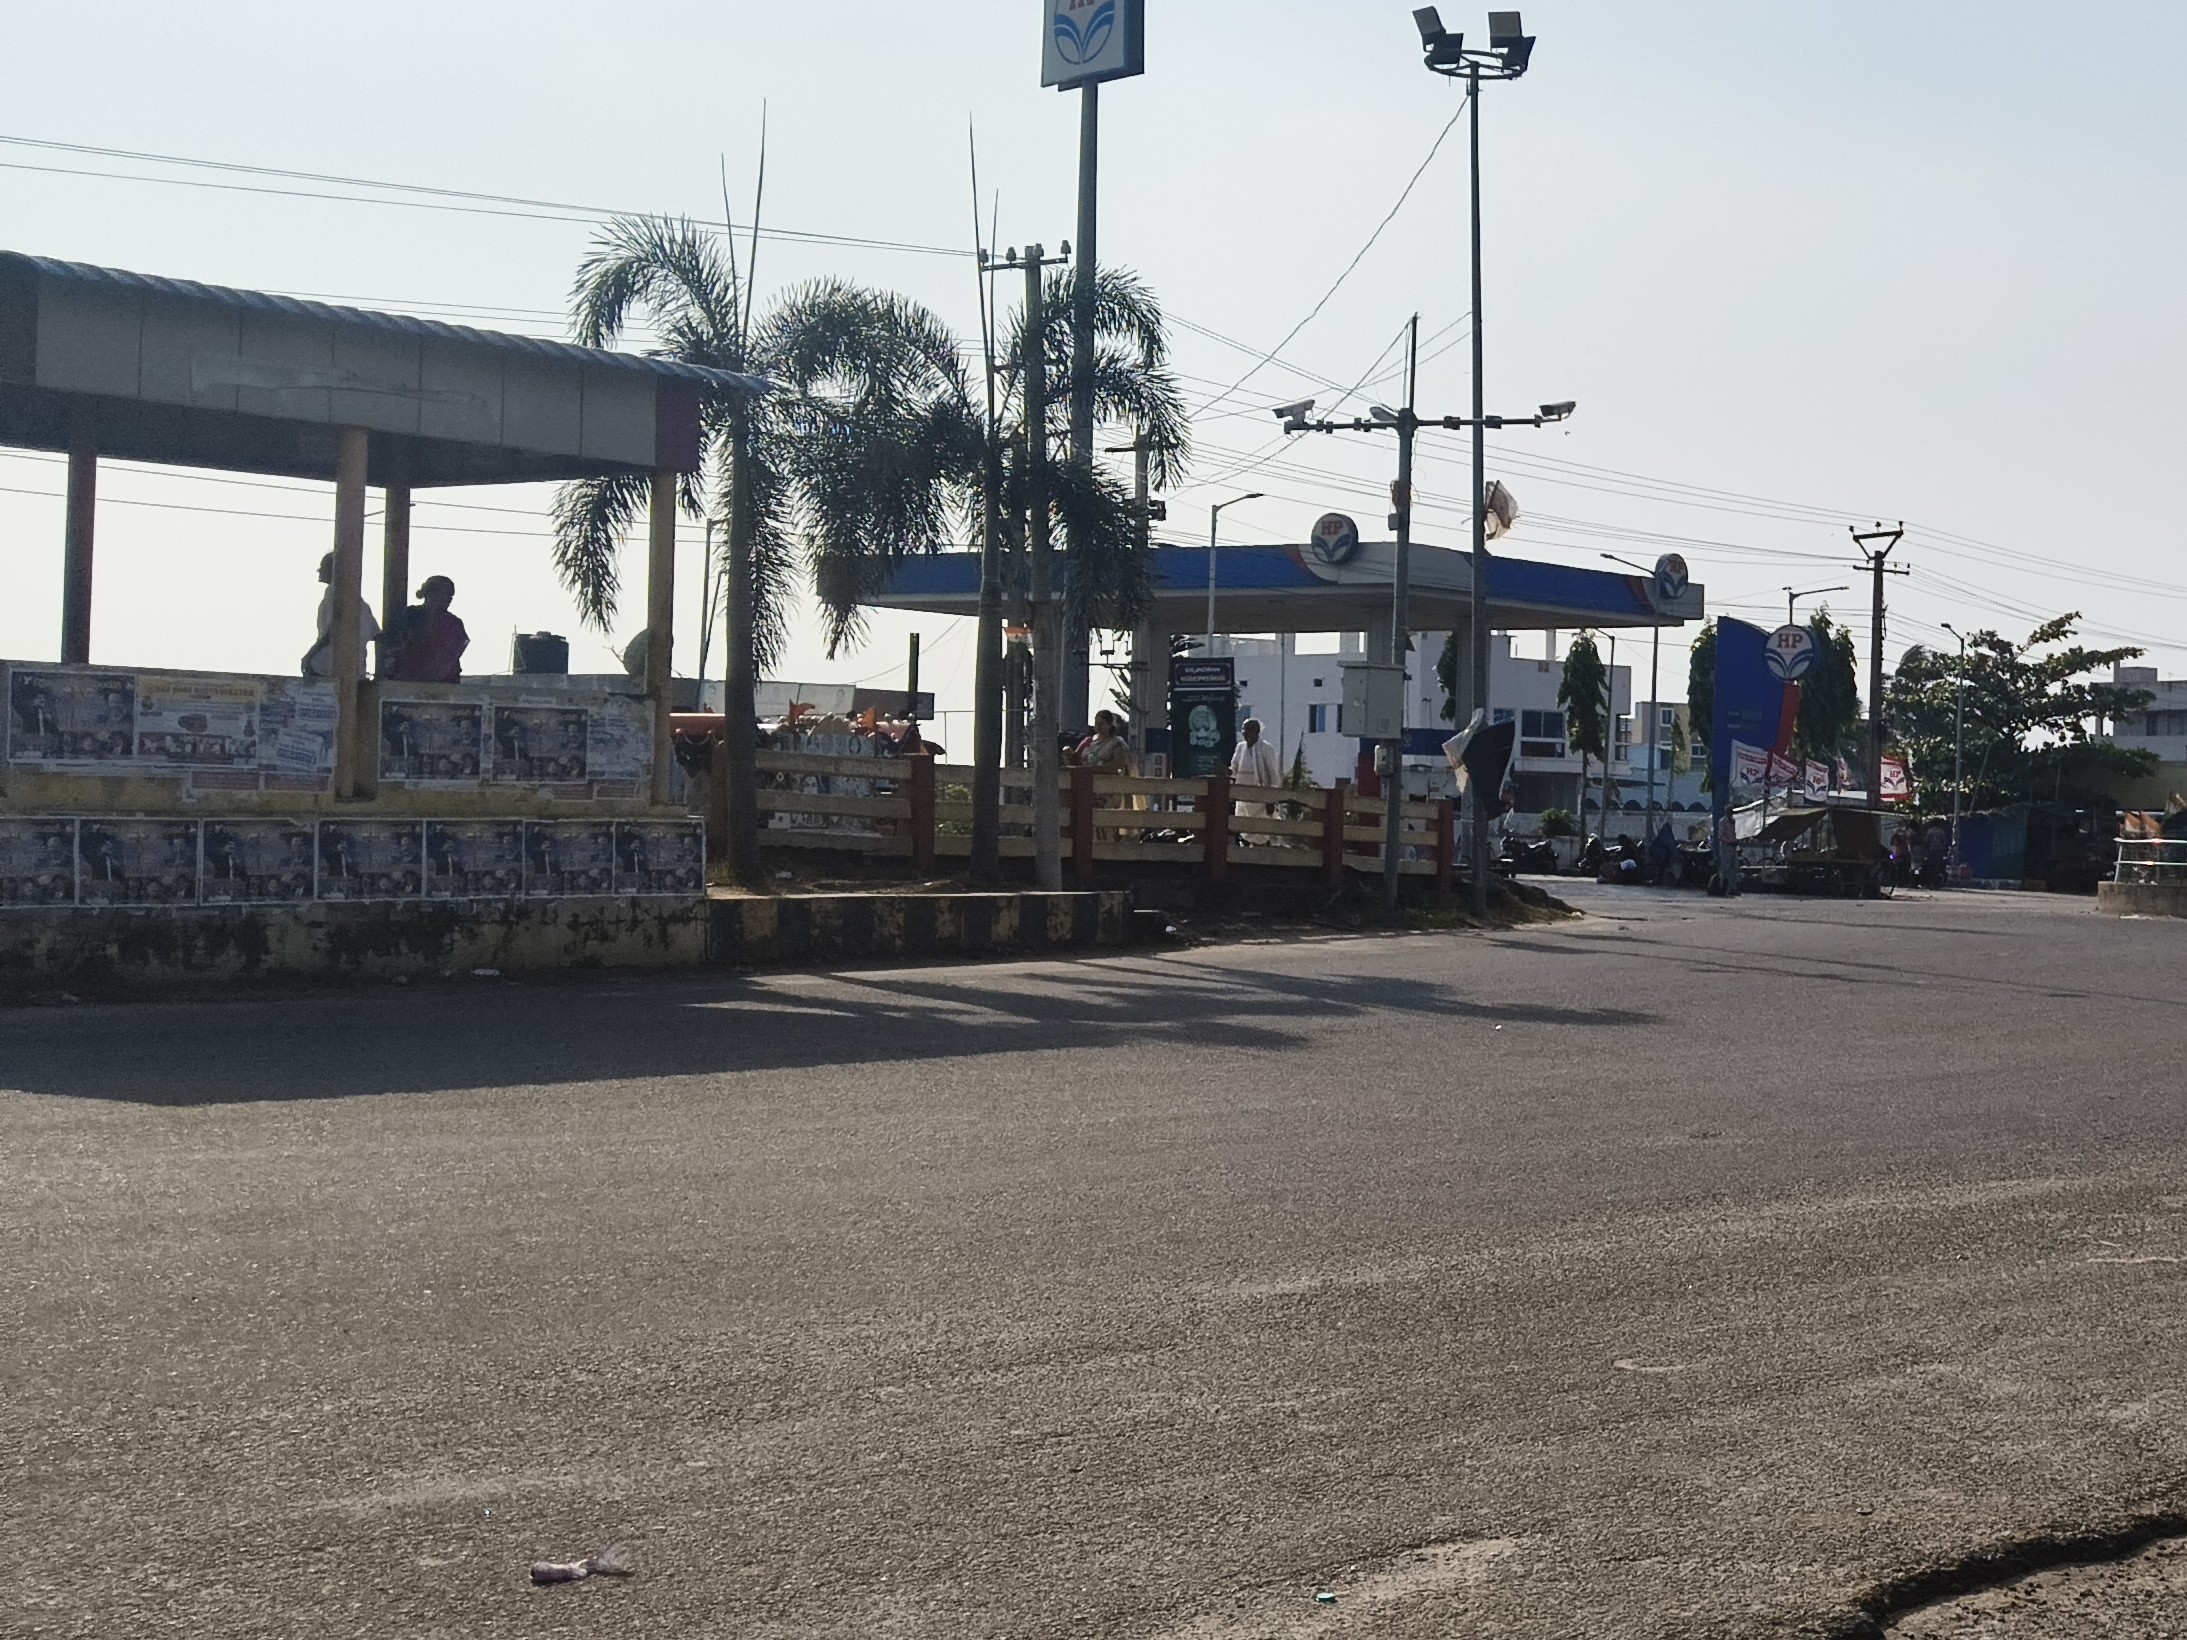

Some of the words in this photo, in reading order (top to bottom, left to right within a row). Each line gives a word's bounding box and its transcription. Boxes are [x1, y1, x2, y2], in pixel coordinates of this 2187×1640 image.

[1321, 520, 1344, 535] HP
[1777, 633, 1803, 649] HP
[1746, 767, 1760, 777] HP
[1889, 770, 1902, 778] HP
